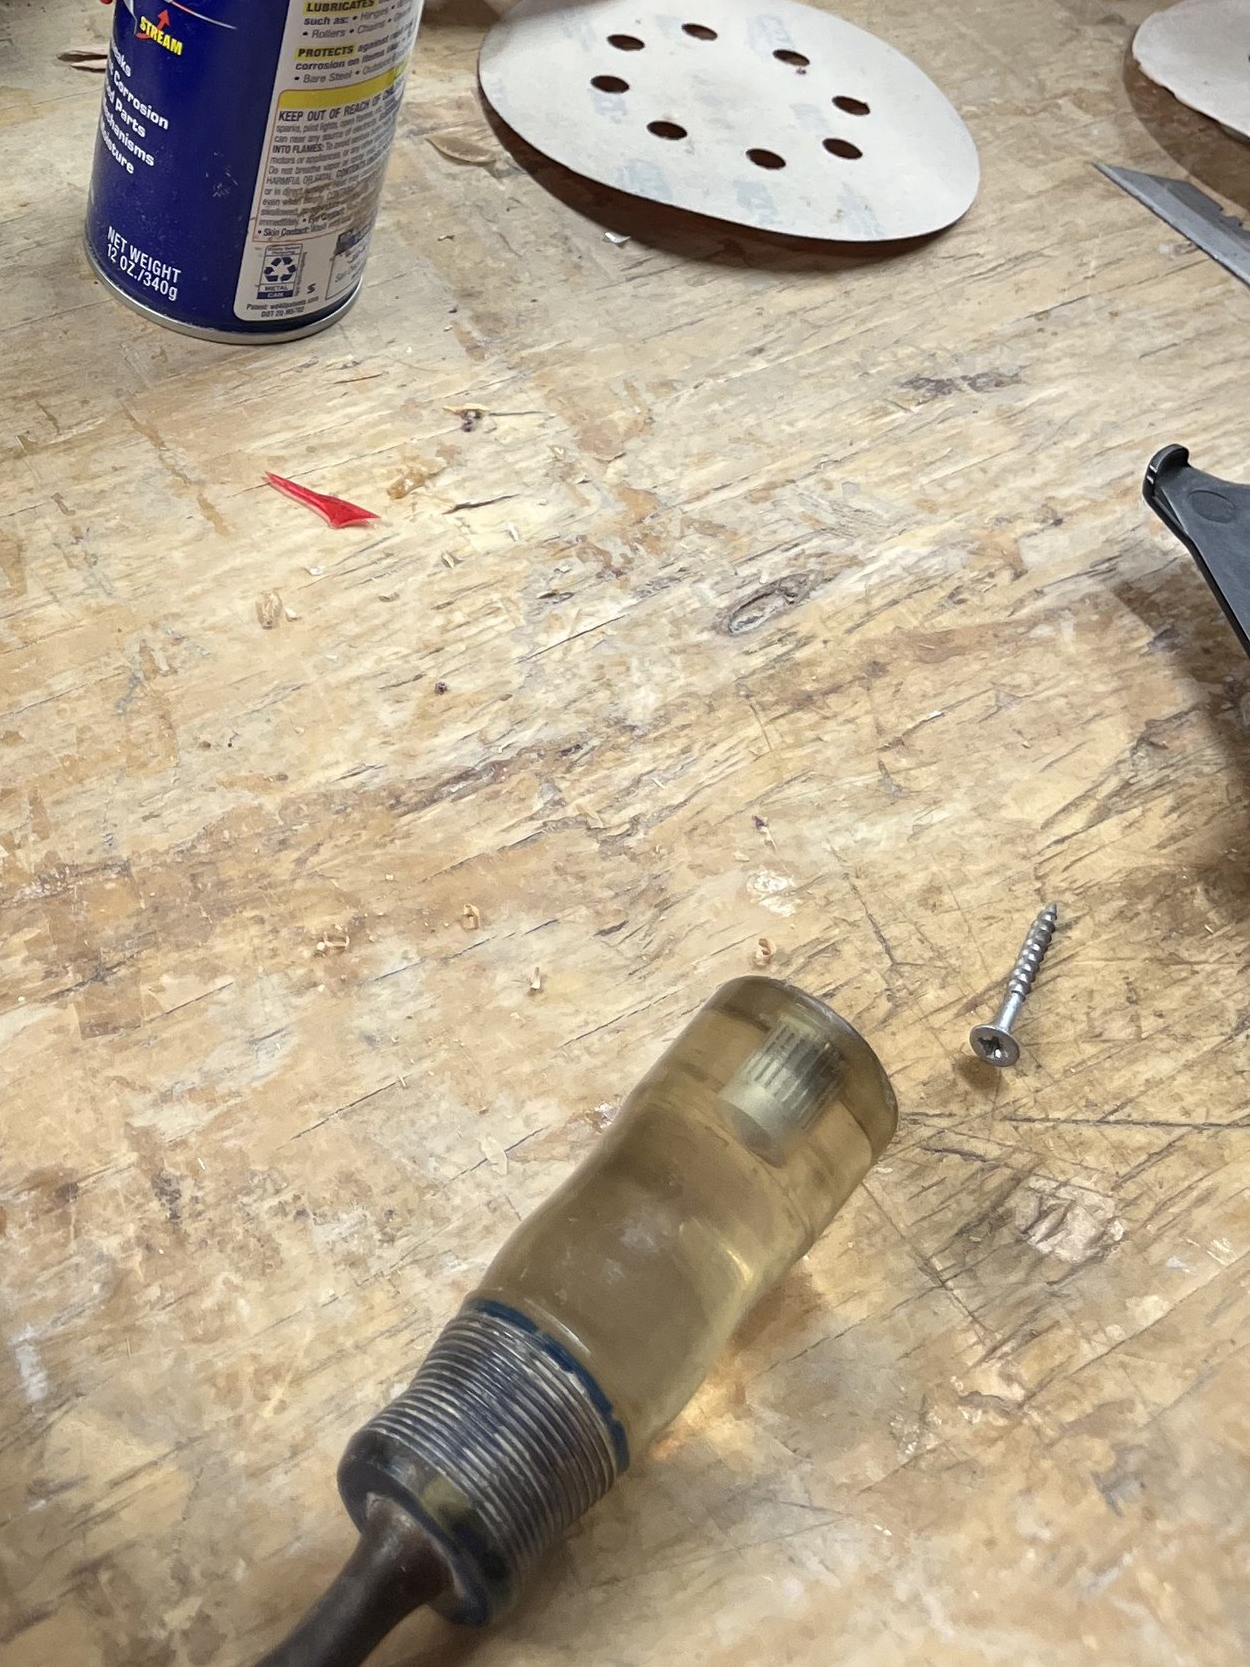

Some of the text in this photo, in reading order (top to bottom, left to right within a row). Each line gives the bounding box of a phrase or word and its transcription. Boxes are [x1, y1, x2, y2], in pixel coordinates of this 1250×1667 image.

[303, 16, 332, 27] such
[139, 15, 183, 56] STREAM
[311, 28, 347, 40] Rollers
[297, 45, 355, 58] PROTECTS
[295, 60, 346, 72] corrosion
[347, 57, 361, 68] on
[302, 73, 327, 84] Bare
[328, 70, 354, 82] Steel
[114, 70, 169, 130] Corrosion
[115, 98, 146, 138] Parts
[278, 110, 303, 122] KEEP
[307, 109, 327, 122] OUT
[329, 107, 342, 120] OF
[343, 100, 370, 117] REACH
[103, 97, 155, 167] echanisms
[274, 135, 287, 143] can
[272, 144, 291, 154] INTO
[292, 143, 324, 154] FLAMES:
[270, 156, 296, 165] motors
[296, 156, 305, 165] or
[268, 166, 279, 175] Do
[263, 227, 281, 238] Skin
[107, 225, 181, 283] NET WEIGHT
[107, 243, 178, 302] 12 OZ./340g
